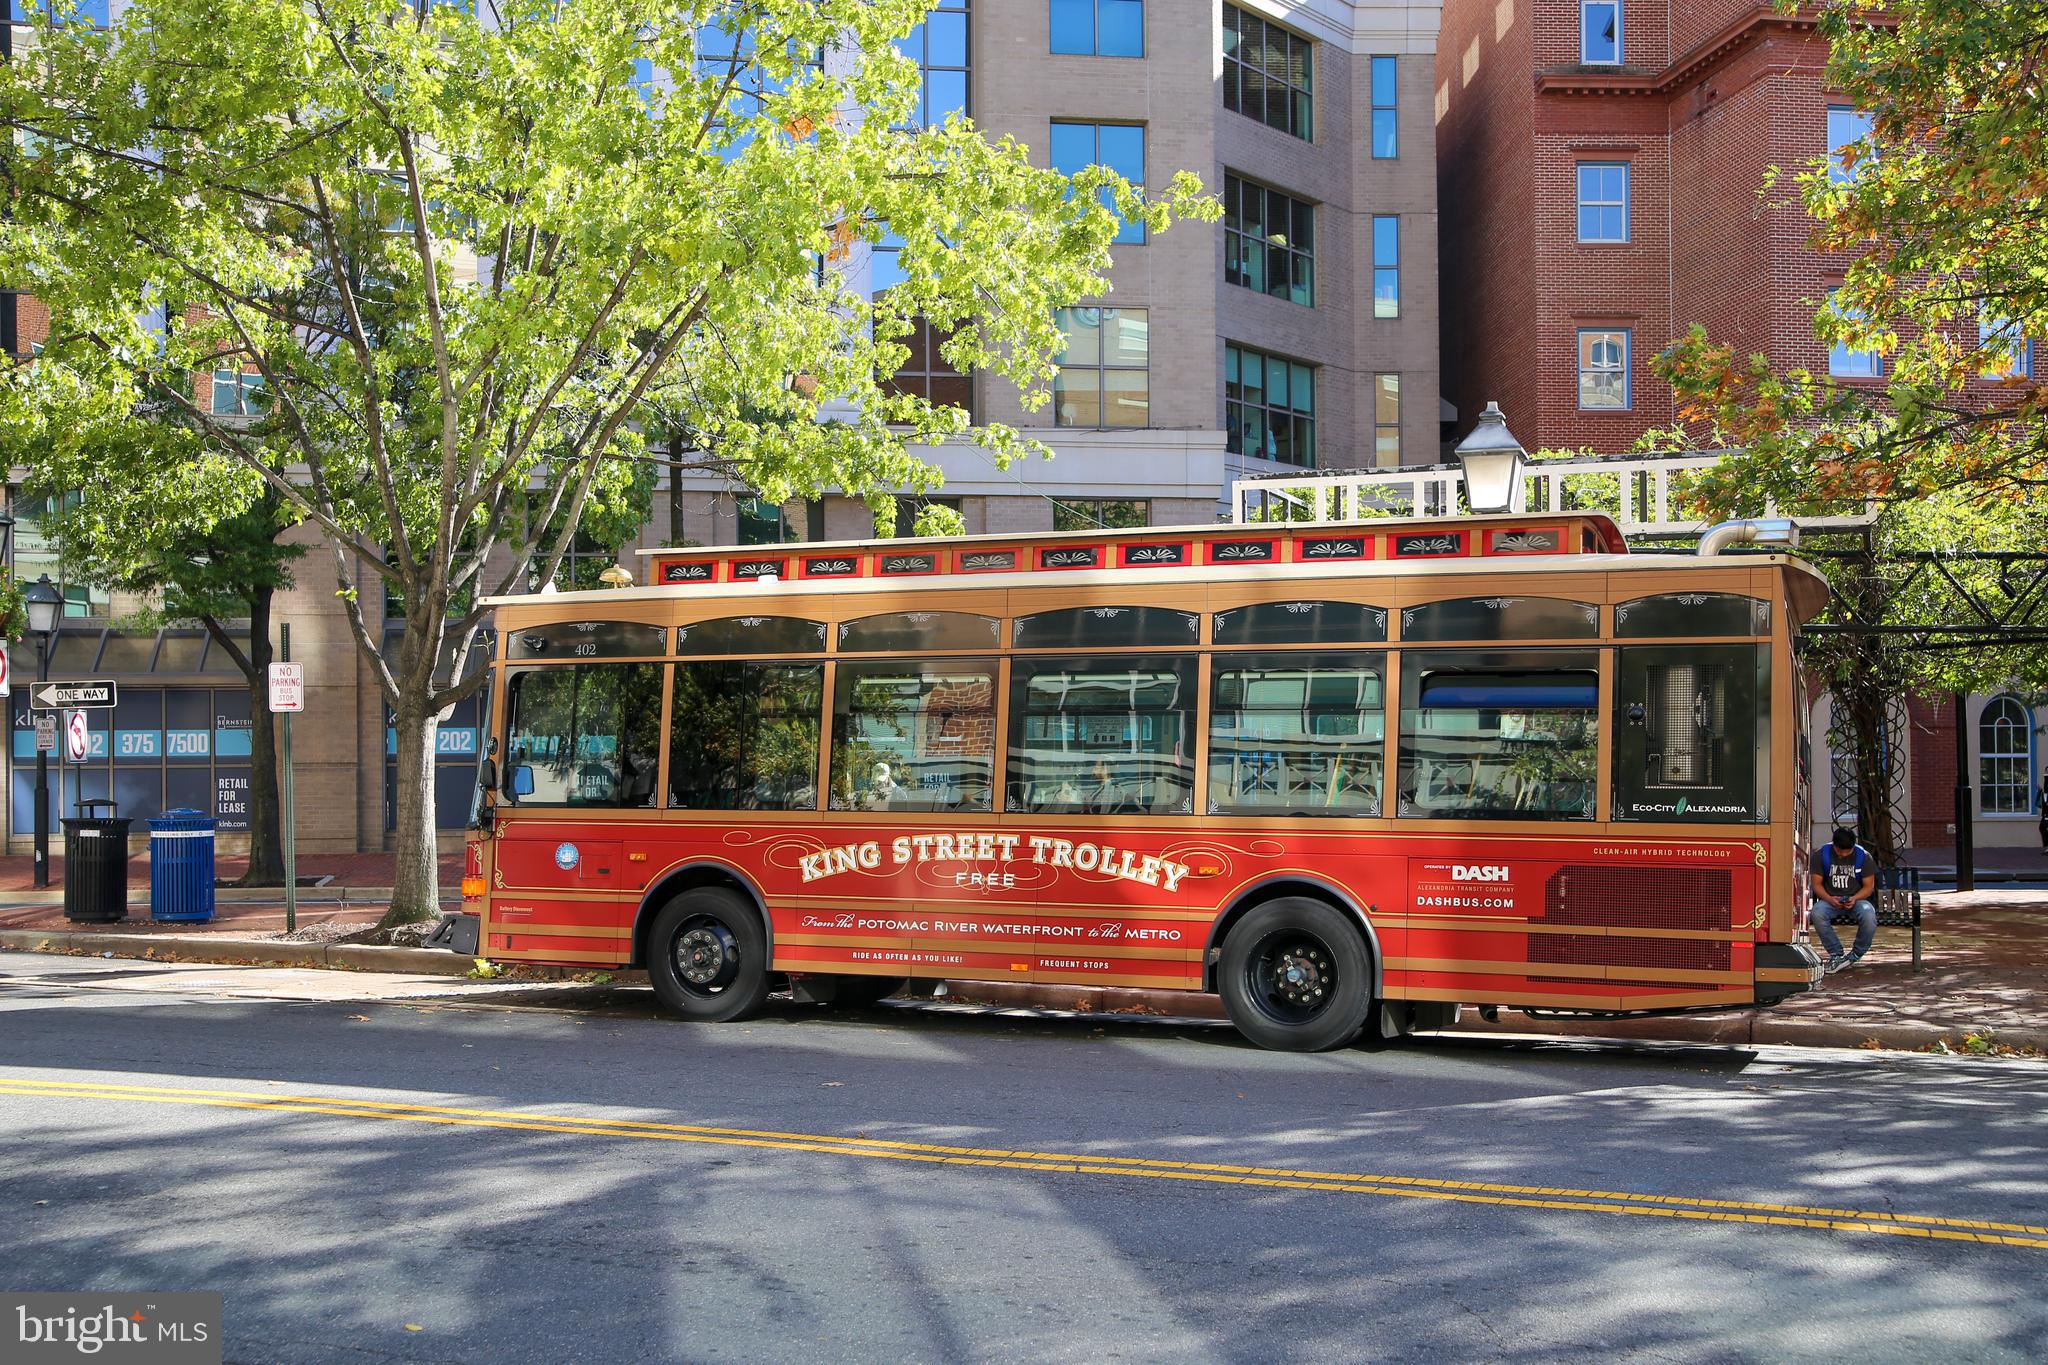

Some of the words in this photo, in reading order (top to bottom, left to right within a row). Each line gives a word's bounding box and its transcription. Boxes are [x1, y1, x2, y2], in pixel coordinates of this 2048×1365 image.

[574, 643, 597, 655] 402
[279, 667, 292, 677] NO
[271, 678, 301, 687] PARKING
[56, 690, 79, 700] ONE
[83, 689, 106, 699] WAY
[122, 733, 154, 753] 375
[167, 733, 208, 753] 7500
[440, 731, 472, 751] 202
[218, 778, 248, 789] RETAIL
[218, 790, 236, 801] FOR
[218, 803, 246, 813] LEASE
[1684, 804, 1747, 813] ALEXANDRIA
[218, 820, 247, 828] klnb.com
[1676, 849, 1731, 857] TECHNOLOGY
[799, 841, 881, 884] KING
[892, 833, 1020, 865] STREET
[1029, 835, 1190, 893] TROLLEY
[955, 872, 1015, 886] FREE
[1451, 865, 1509, 882] DASH
[1417, 884, 1455, 892] ALEXANDRIA
[1417, 896, 1514, 908] DASHBUS.COM
[801, 915, 835, 928] From
[834, 913, 856, 929] the
[858, 919, 929, 931] POTOMAC
[934, 921, 978, 933] RIVER
[982, 924, 1084, 937] WATERFRONT
[1087, 927, 1100, 938] to
[1099, 923, 1122, 938] the
[1124, 928, 1182, 941] METRO
[885, 953, 909, 961] OFTEN
[924, 954, 939, 962] YOU
[942, 955, 963, 963] LIKE!
[1039, 959, 1080, 968] FREQUENT
[1083, 961, 1109, 969] STOPS
